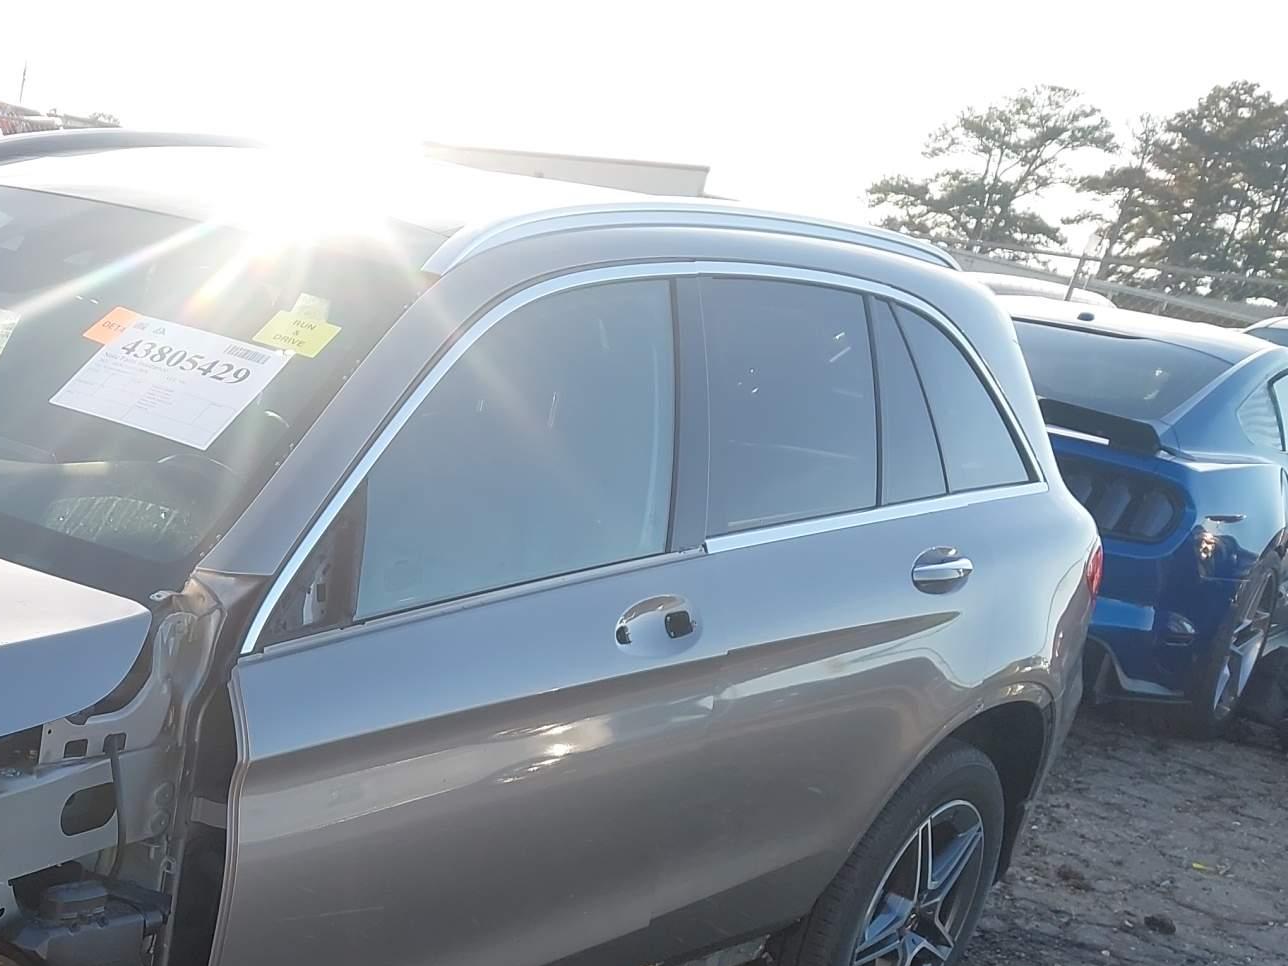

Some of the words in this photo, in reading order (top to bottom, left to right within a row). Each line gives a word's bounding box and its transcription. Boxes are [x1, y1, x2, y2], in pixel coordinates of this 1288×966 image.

[292, 319, 317, 333] RUN
[271, 333, 306, 347] DRIVE
[122, 338, 251, 385] 43805429
